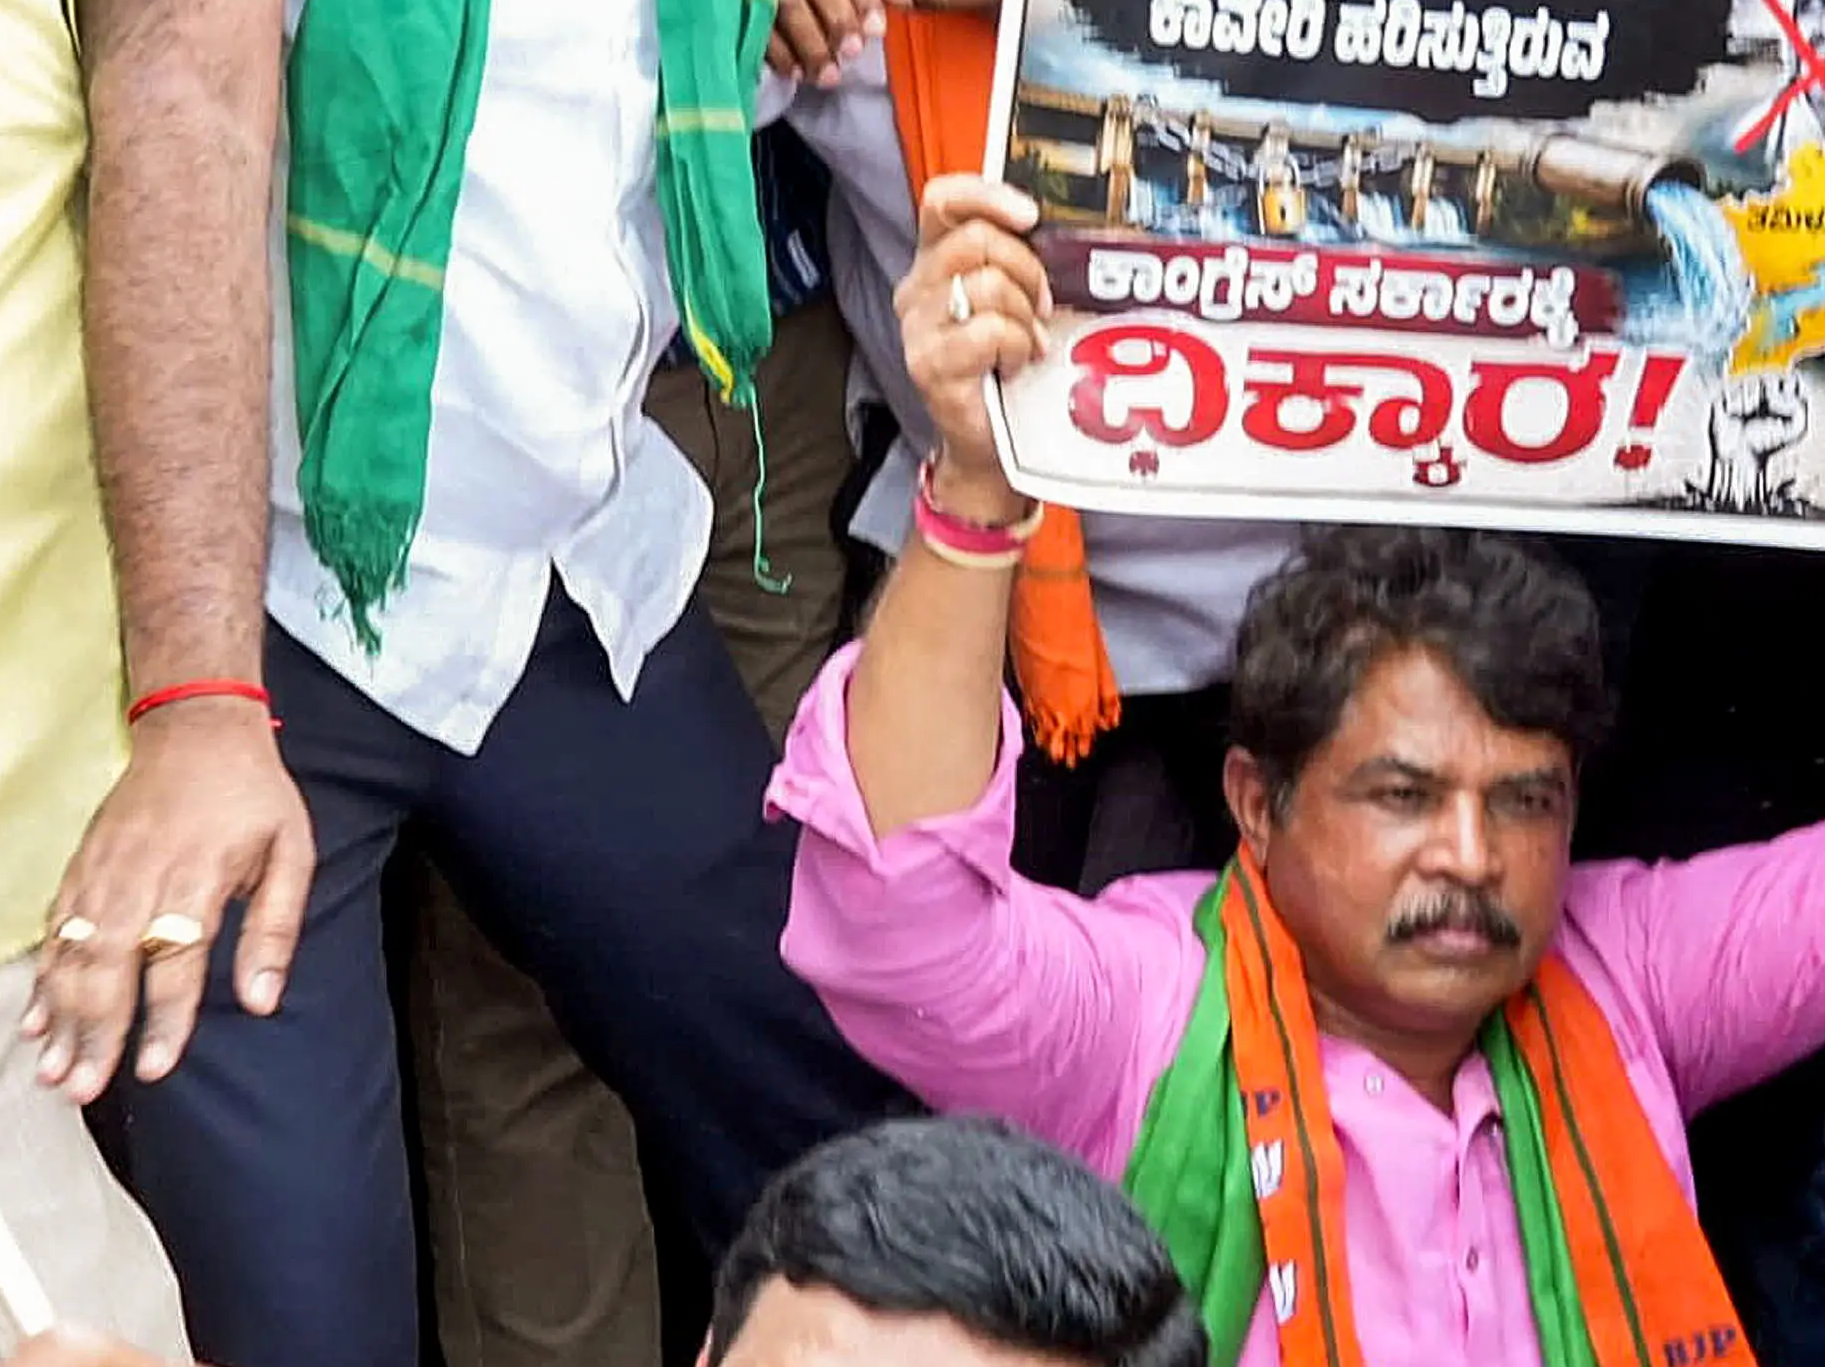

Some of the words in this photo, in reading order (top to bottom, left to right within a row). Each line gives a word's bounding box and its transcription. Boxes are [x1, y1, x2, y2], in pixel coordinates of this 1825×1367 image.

[1087, 245, 1319, 323] ಕಾಂಗ್ರೆಸ್
[1328, 255, 1580, 350] ಸರ್ಕಾರಕ್ಕೆ
[1068, 322, 1687, 490] ಧಿಕ್ಕಾರ!
